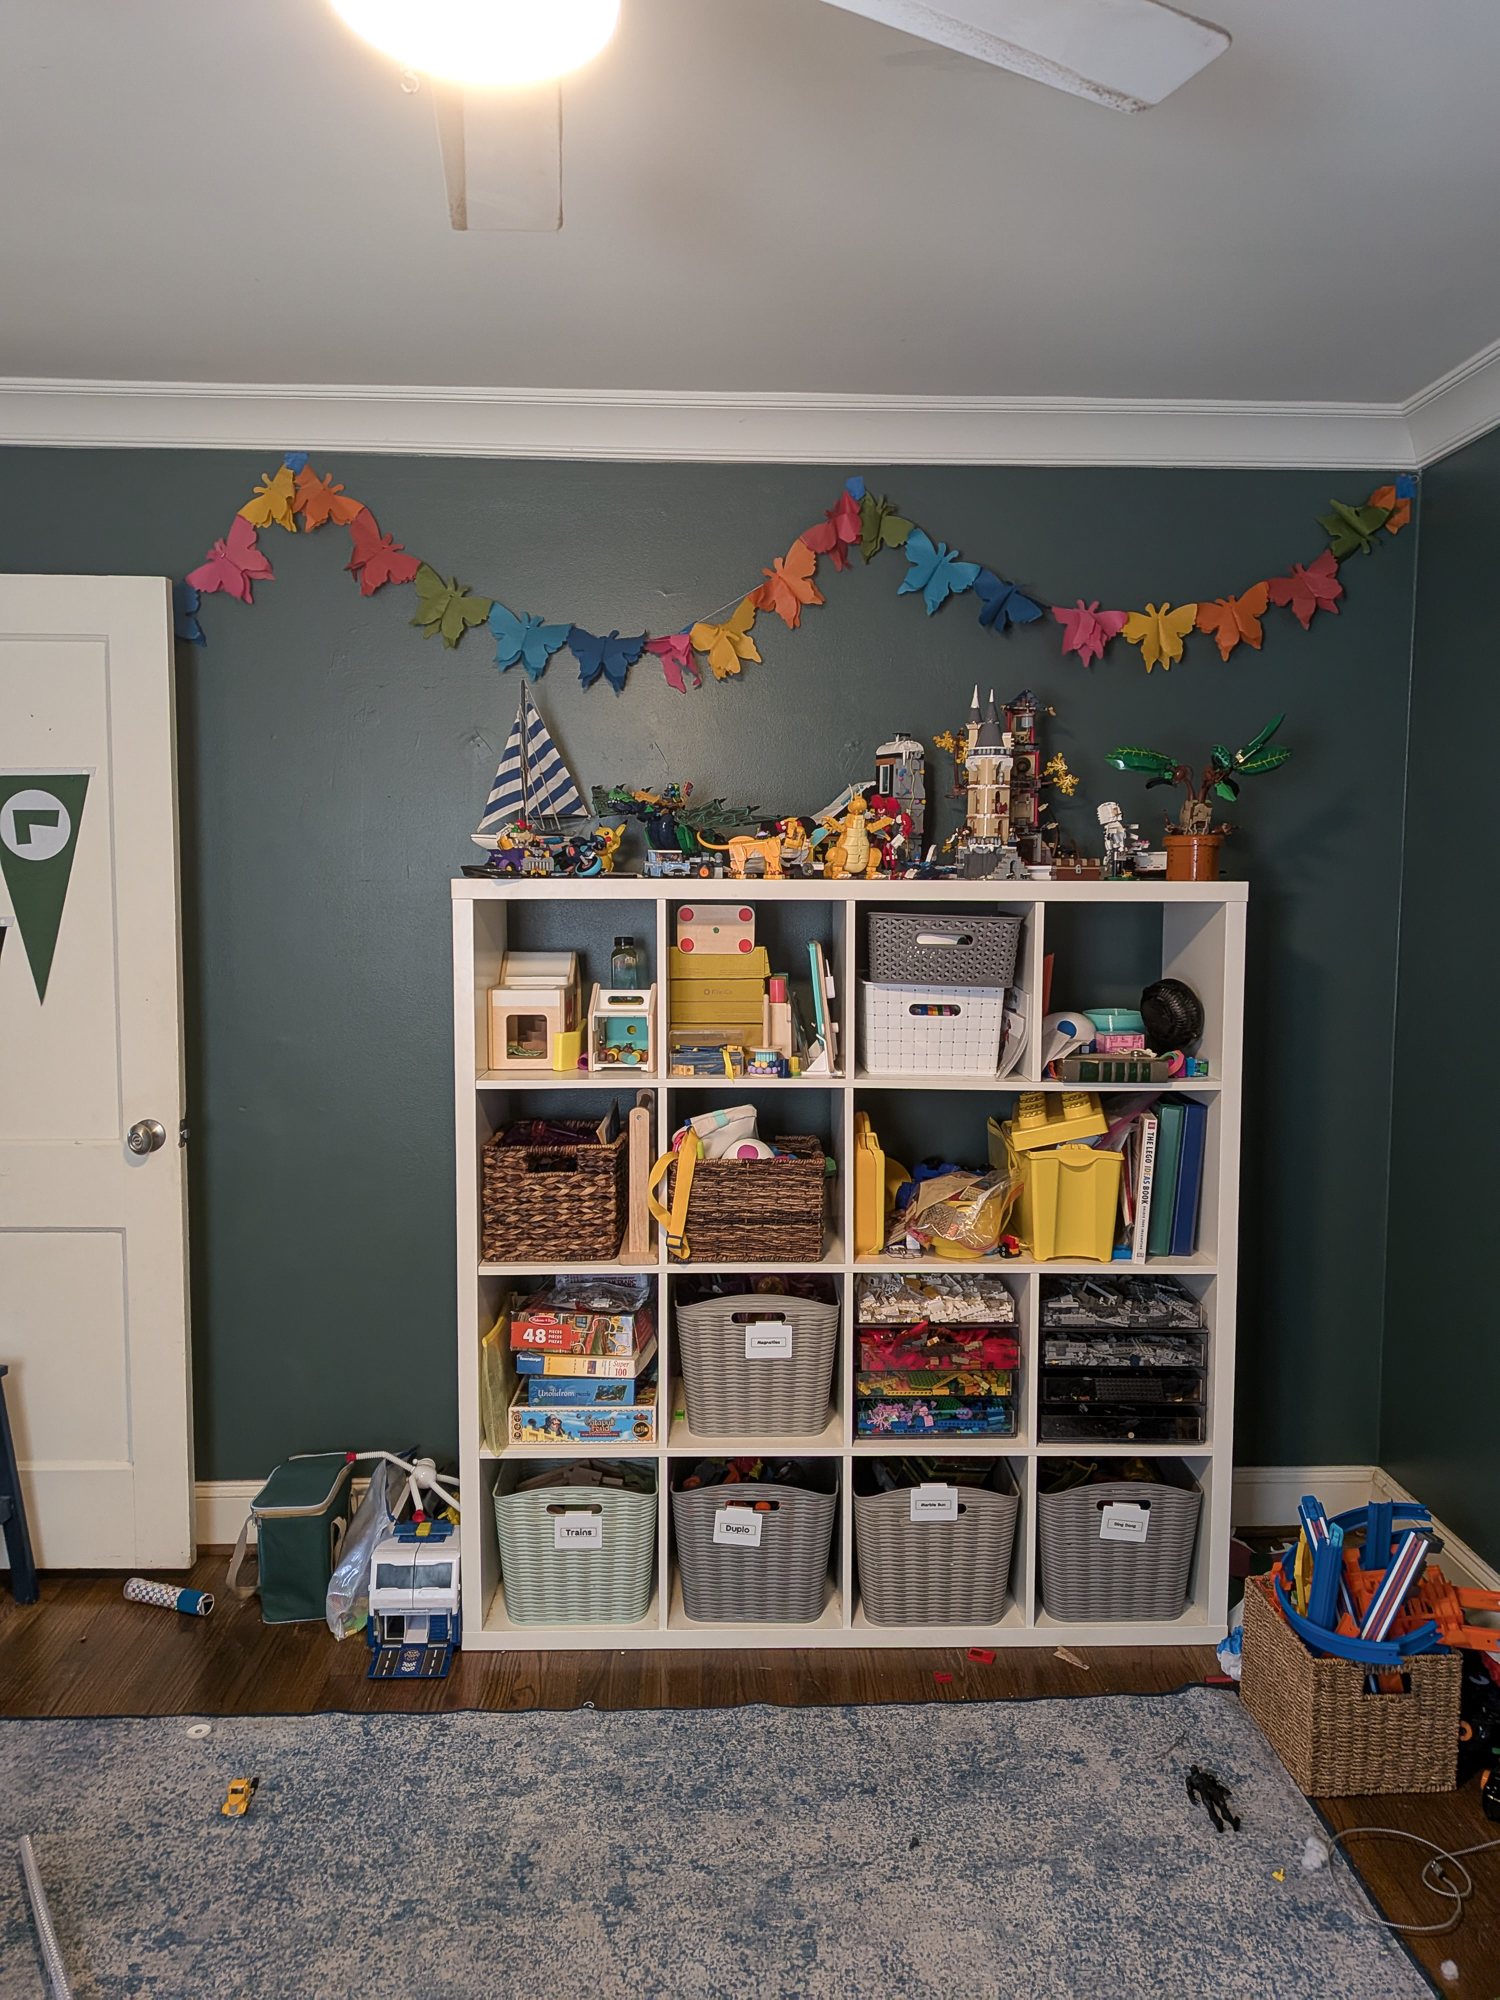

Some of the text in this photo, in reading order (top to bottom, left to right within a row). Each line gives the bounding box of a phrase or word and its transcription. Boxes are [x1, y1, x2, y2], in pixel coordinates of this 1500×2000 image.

[1146, 1132, 1155, 1145] THE
[1145, 1146, 1154, 1164] LEGO
[1143, 1165, 1152, 1185] IDEAS
[1141, 1185, 1150, 1205] BOOK
[523, 1328, 547, 1344] 48
[613, 1360, 630, 1368] Super
[615, 1368, 628, 1377] 100
[584, 1415, 616, 1427] Catapult
[565, 1528, 592, 1536] Trains
[725, 1524, 750, 1534] Duplo
